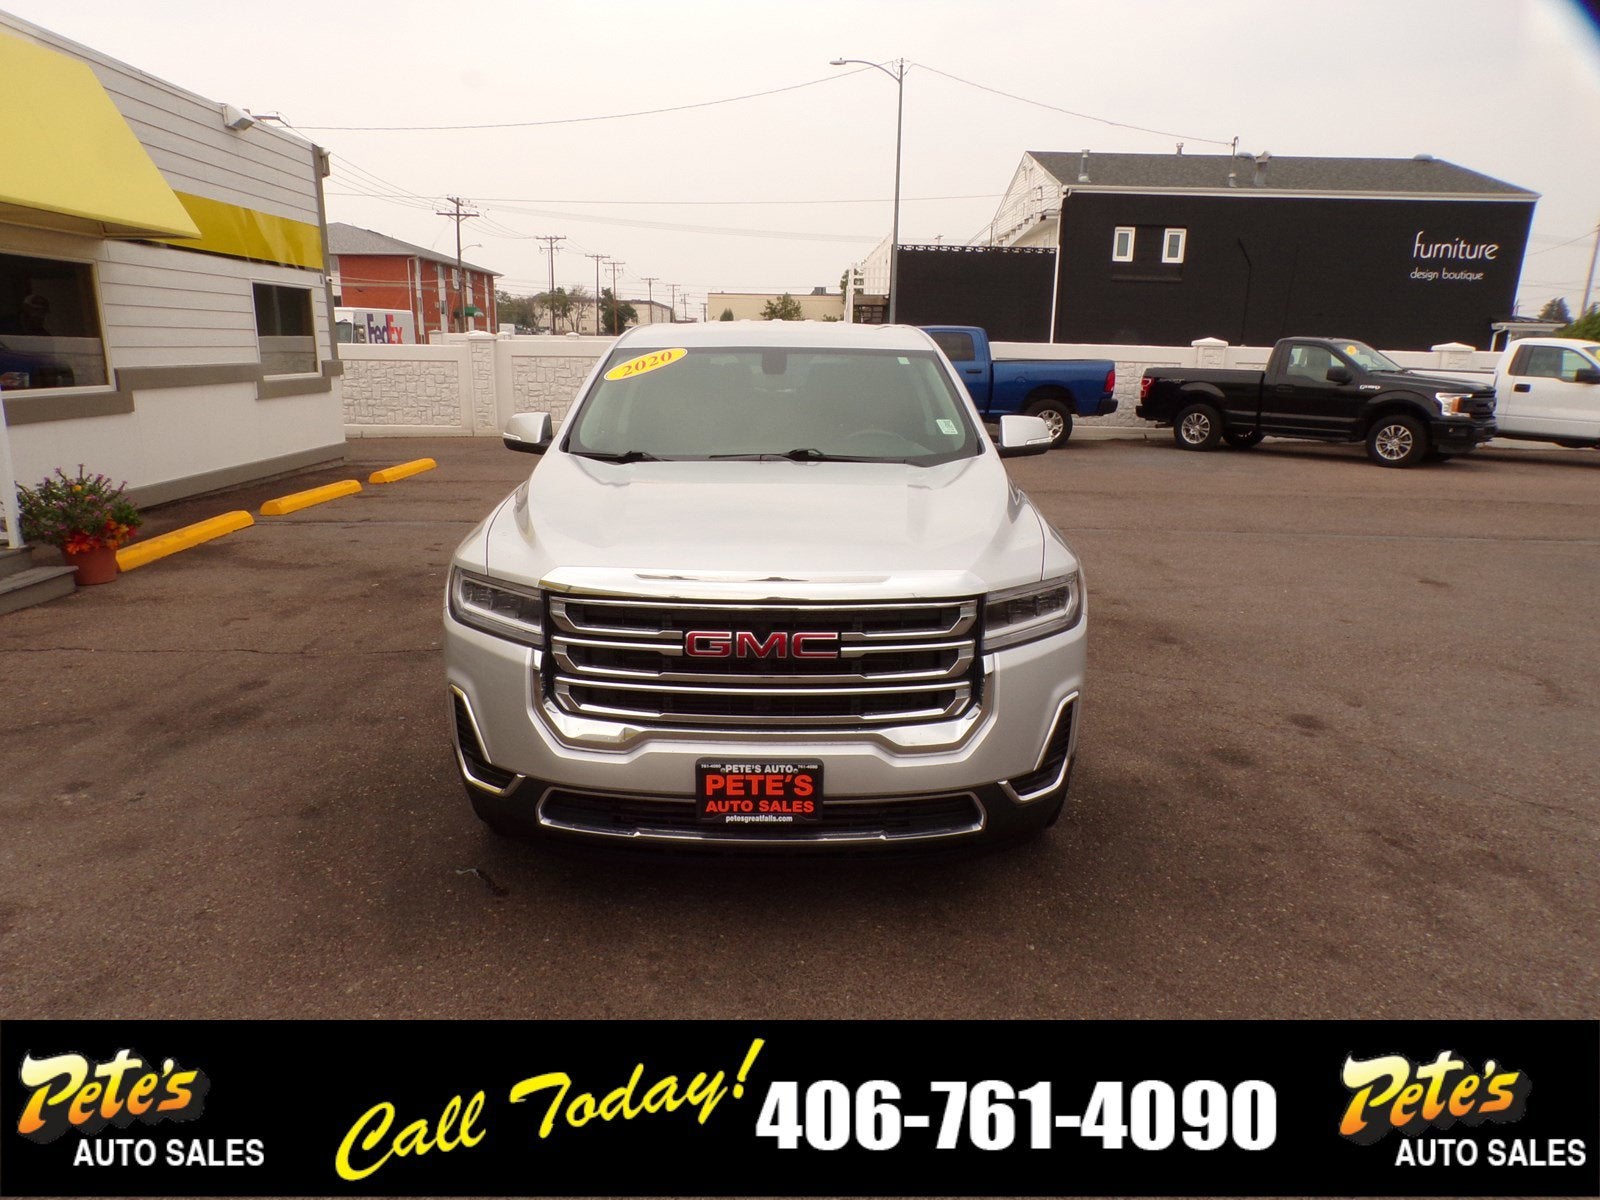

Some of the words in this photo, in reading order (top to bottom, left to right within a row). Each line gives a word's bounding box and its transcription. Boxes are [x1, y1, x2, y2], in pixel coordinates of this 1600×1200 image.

[1413, 230, 1499, 260] furniture
[1410, 267, 1439, 281] design
[1442, 267, 1484, 281] boutique
[366, 313, 403, 344] FedEx
[622, 351, 672, 377] 2020
[685, 630, 839, 659] GMC
[725, 764, 761, 773] PETE'S
[764, 764, 793, 773] AUTO
[705, 774, 814, 796] PETE'S
[705, 800, 753, 813] AUTO
[758, 800, 815, 813] SALES
[725, 814, 793, 823] petesgreatfalls.com
